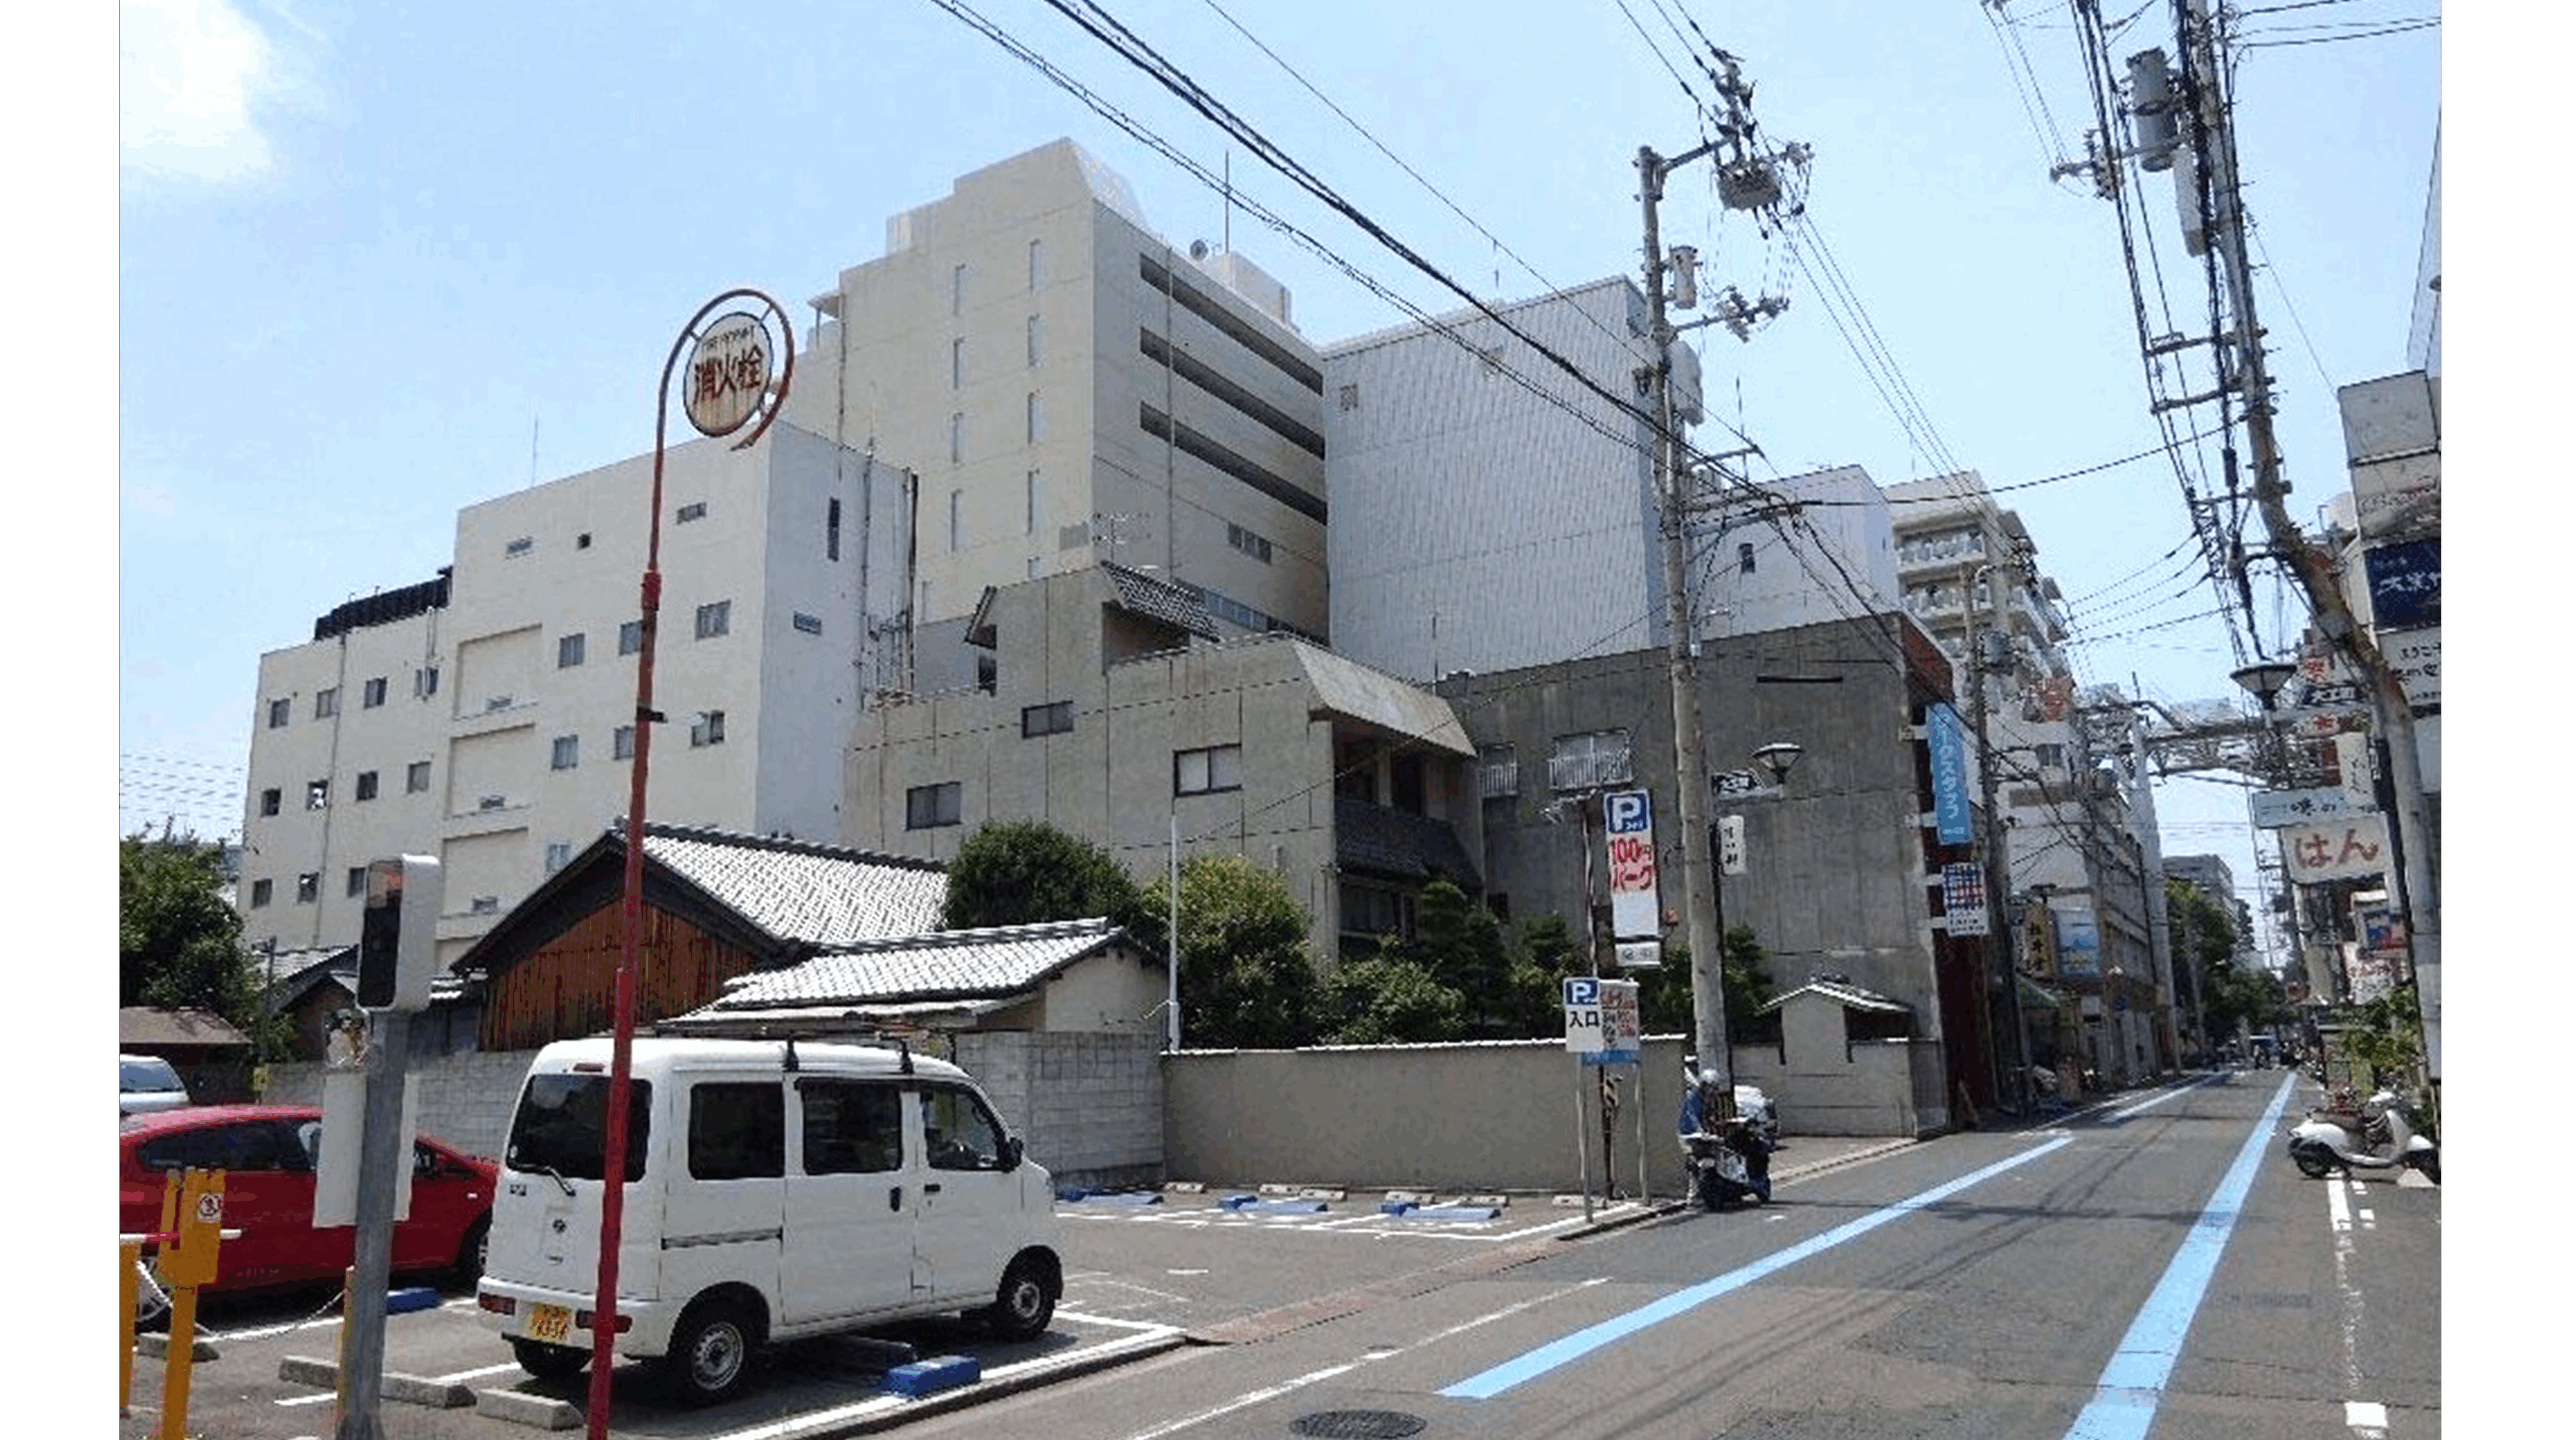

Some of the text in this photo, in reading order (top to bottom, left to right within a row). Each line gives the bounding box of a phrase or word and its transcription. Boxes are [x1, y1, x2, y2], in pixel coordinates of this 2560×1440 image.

[693, 344, 764, 406] 消火栓
[1613, 796, 1641, 831] P
[1613, 865, 1652, 891] パーク
[1571, 981, 1592, 1004] P
[1569, 1011, 1600, 1028] 入口
